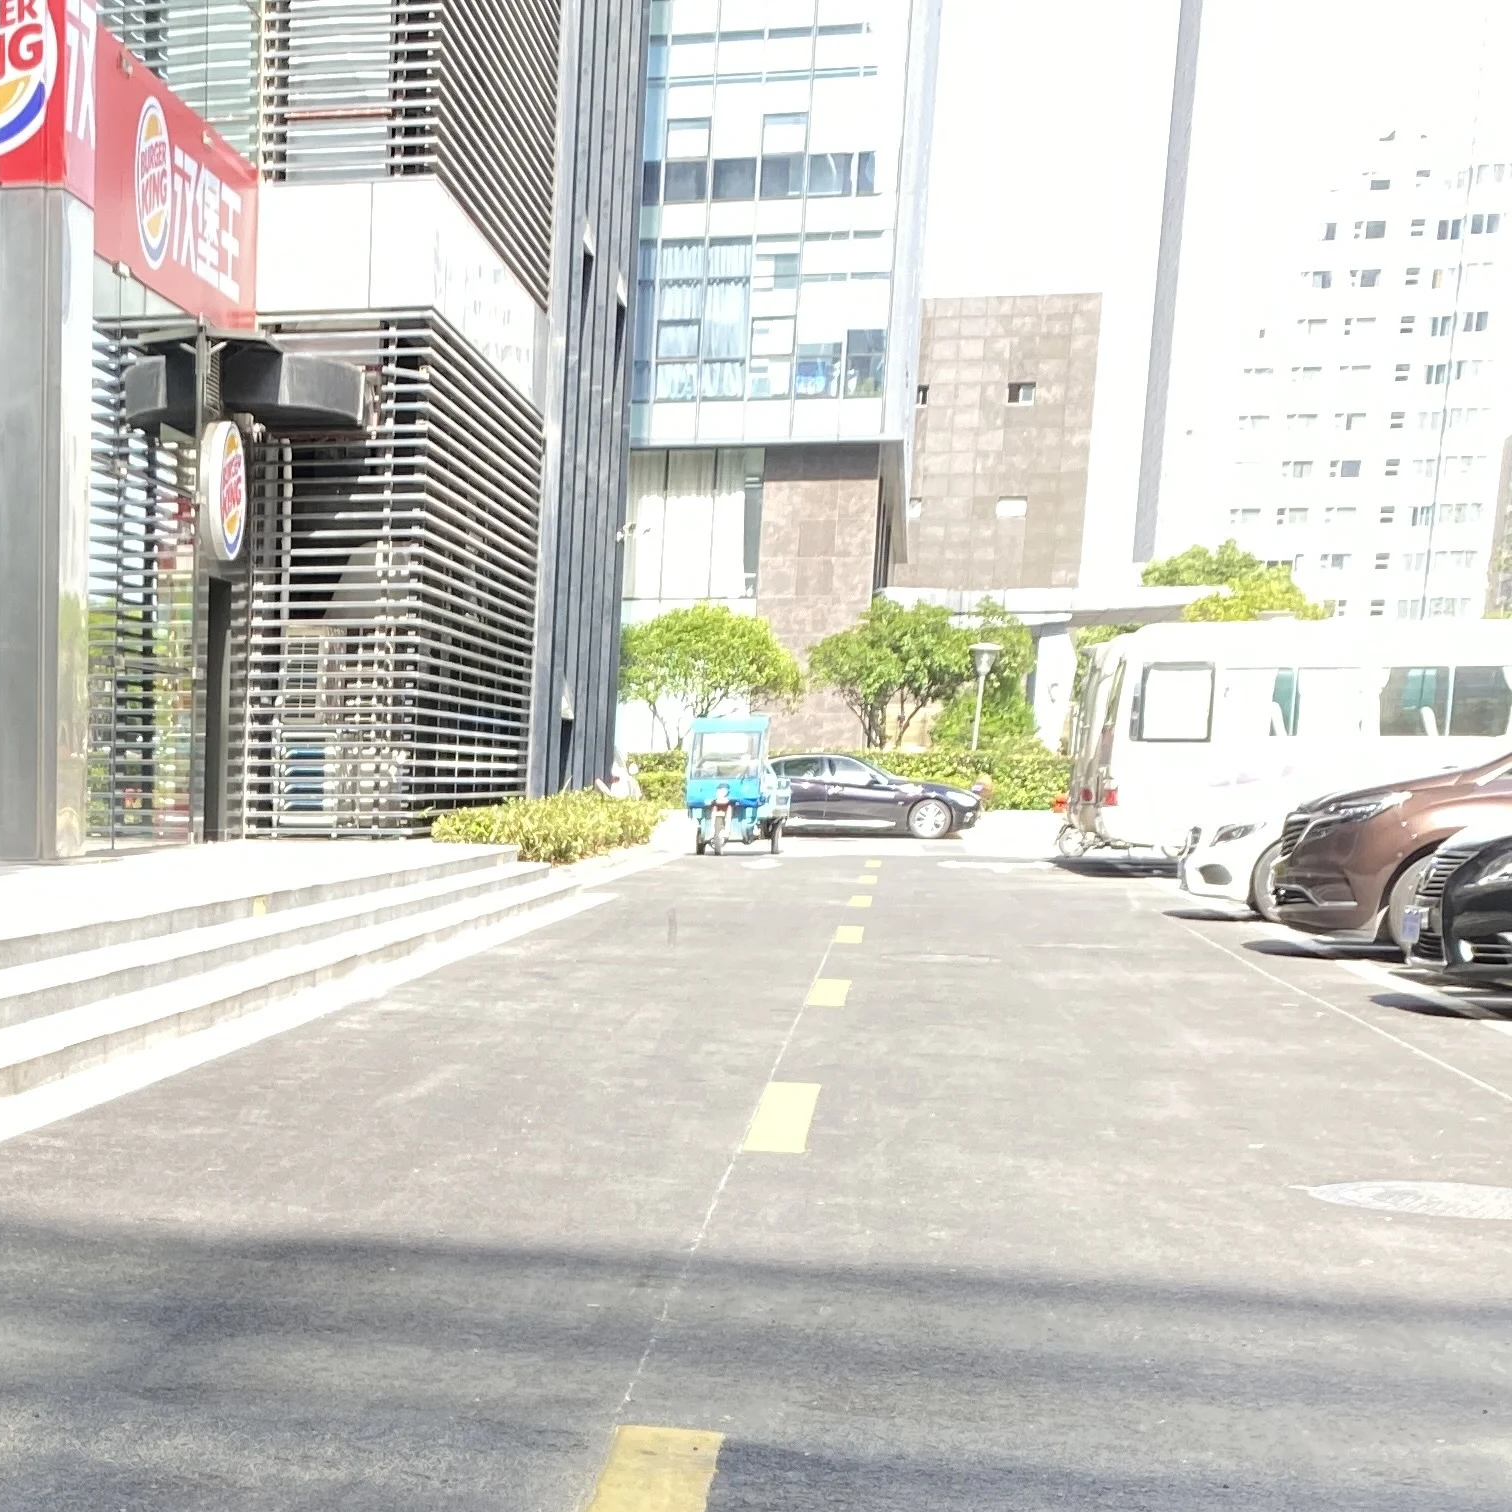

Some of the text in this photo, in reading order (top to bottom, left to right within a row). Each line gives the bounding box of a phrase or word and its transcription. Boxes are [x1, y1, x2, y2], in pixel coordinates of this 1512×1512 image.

[140, 141, 167, 178] BURGER
[141, 168, 168, 218] KING
[172, 143, 242, 304] 汉堡王
